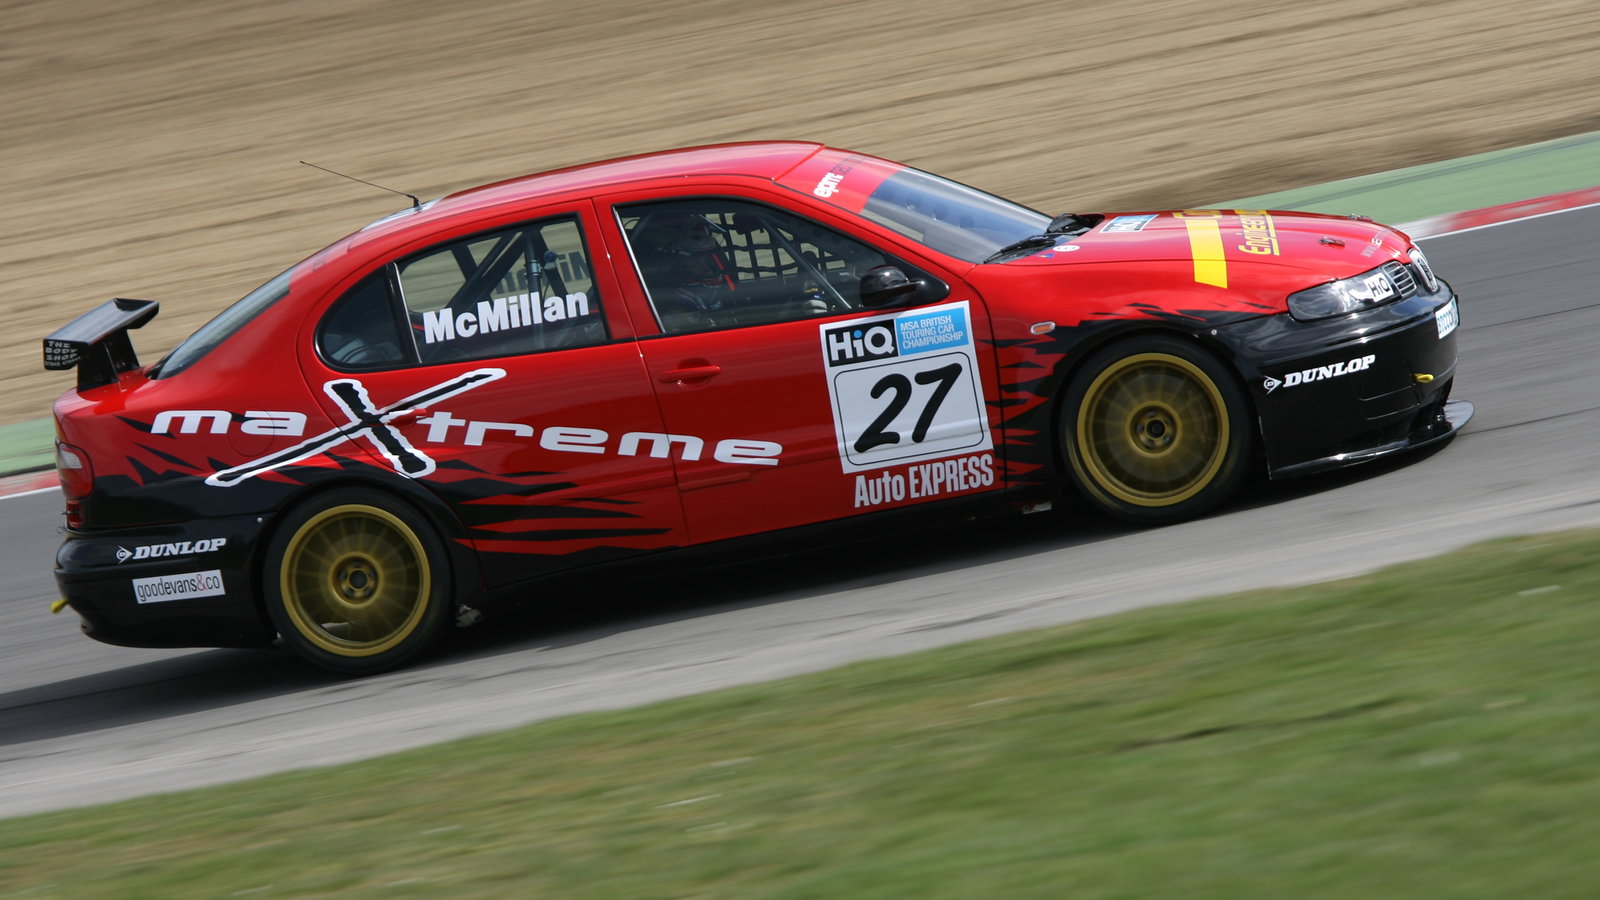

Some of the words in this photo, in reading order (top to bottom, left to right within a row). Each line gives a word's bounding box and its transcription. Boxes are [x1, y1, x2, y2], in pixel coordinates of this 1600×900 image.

[1235, 209, 1276, 255] Enginee
[1368, 277, 1390, 298] HiQ
[422, 291, 589, 344] McMillan
[900, 320, 920, 332] MSA
[920, 315, 952, 328] BRITISH
[901, 327, 937, 340] TOURING
[938, 324, 955, 335] CAR
[828, 325, 895, 361] HiQ
[902, 331, 964, 350] CHAMPIONSHIP
[1282, 354, 1376, 388] DUNLOP
[853, 362, 963, 454] 27
[854, 470, 906, 508] Auto
[908, 453, 994, 499] EXPRESS
[132, 537, 227, 560] DUNLOP
[136, 573, 221, 602] goodevans&co
